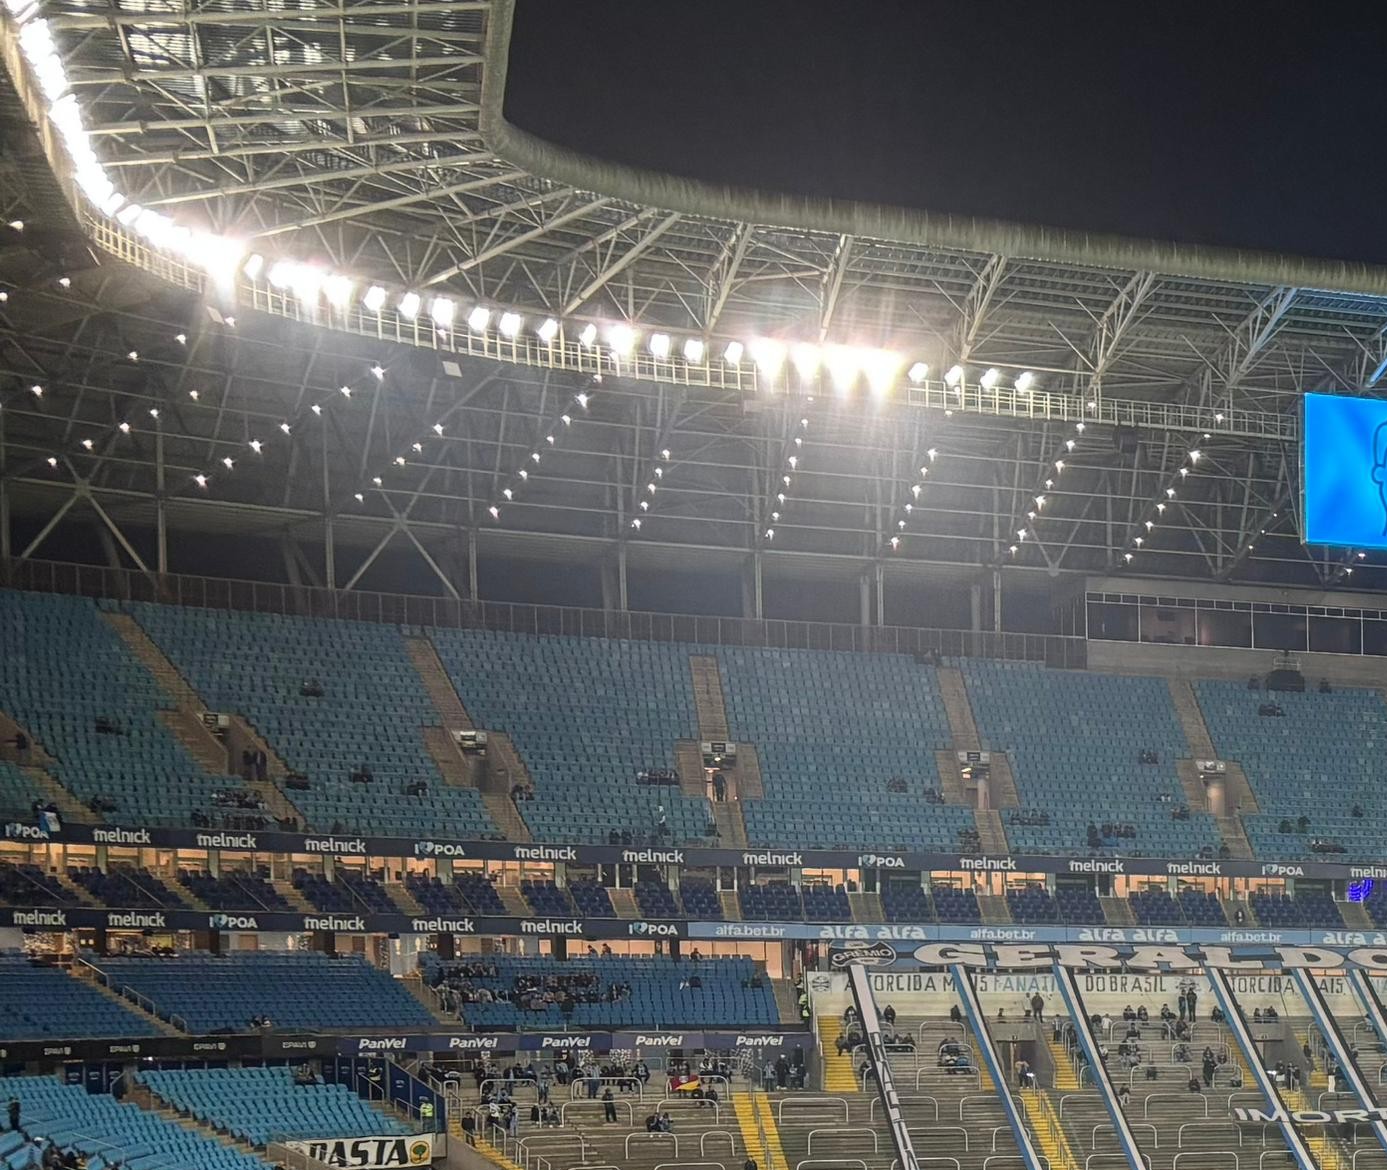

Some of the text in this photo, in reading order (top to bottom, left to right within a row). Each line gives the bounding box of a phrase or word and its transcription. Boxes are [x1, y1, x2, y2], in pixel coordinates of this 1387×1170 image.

[92, 826, 151, 844] melnick
[433, 841, 465, 856] POA
[622, 848, 684, 863] melnick
[742, 851, 803, 865] melnick
[1278, 863, 1305, 876] POA
[13, 909, 67, 926] melnick
[107, 911, 166, 927] melnick
[226, 913, 258, 929] POA
[714, 923, 789, 938] alfa.bet.br
[819, 924, 929, 940] alfa alfa
[1220, 931, 1283, 944] alfa.bet.br
[1322, 931, 1370, 947] alfa
[915, 944, 1264, 971] GERAL
[942, 973, 989, 993] MIS
[1110, 974, 1167, 993] BRASIL
[1231, 976, 1295, 994] TORCIDA
[358, 1037, 407, 1050] PanVel
[541, 1036, 591, 1048] PanVel
[735, 1035, 784, 1046] PanVel
